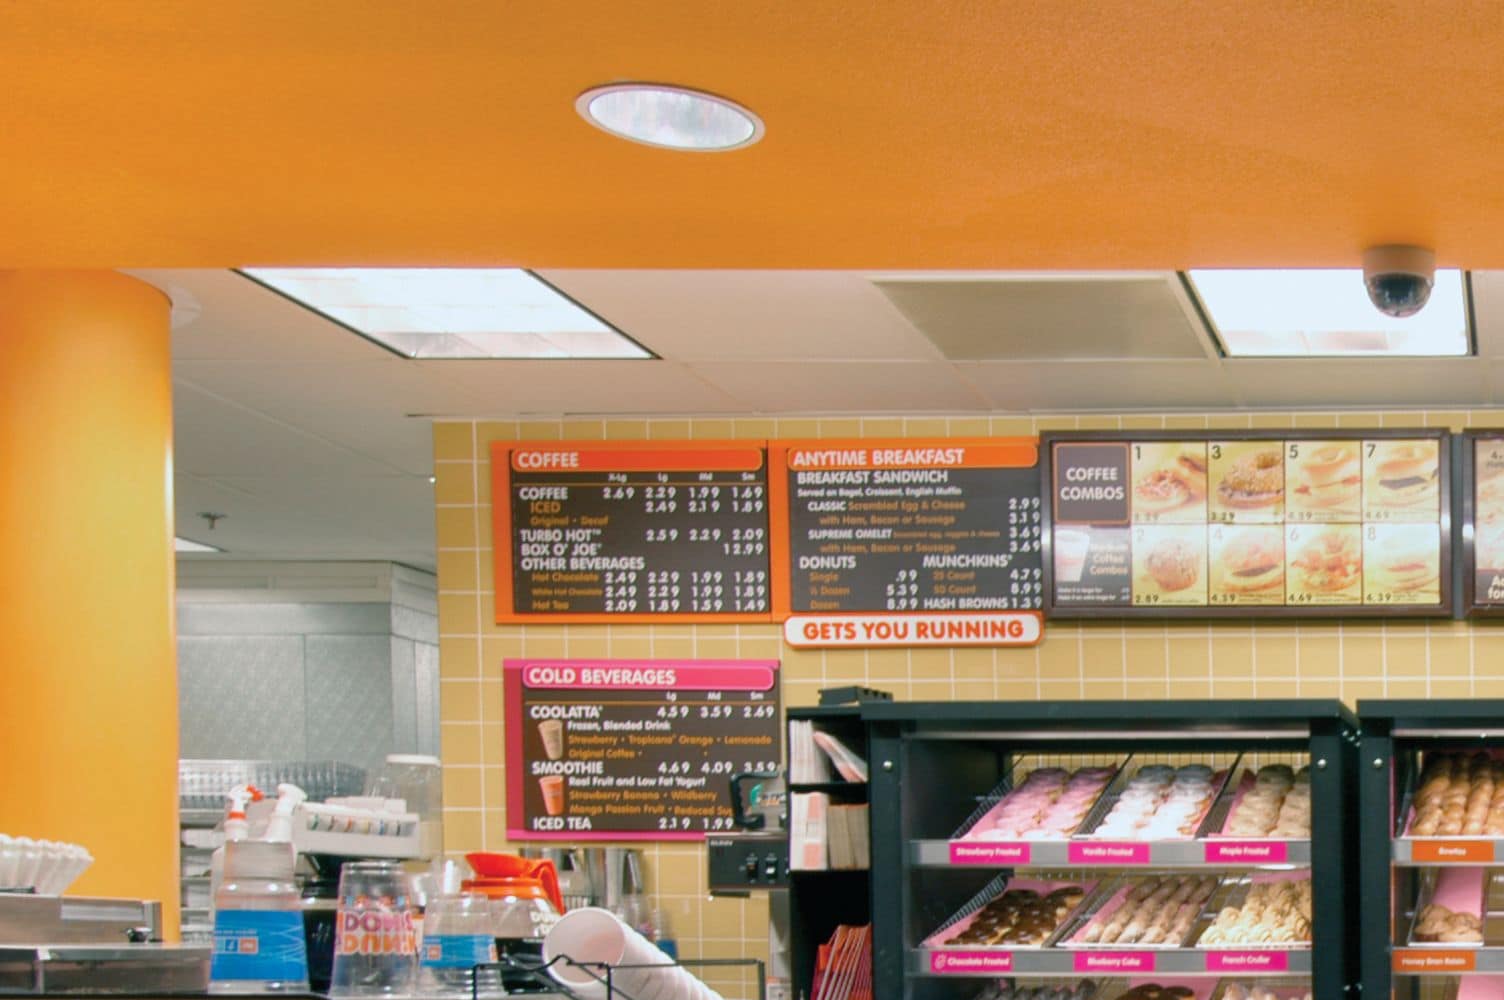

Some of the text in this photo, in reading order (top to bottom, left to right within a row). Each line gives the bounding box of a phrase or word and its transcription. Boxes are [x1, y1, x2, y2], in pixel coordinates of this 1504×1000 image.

[794, 449, 965, 466] ANYTIME BREAKFAST
[1134, 444, 1375, 460] 1 3 5 7
[518, 452, 579, 467] COFFEE
[798, 471, 948, 484] BREAKFAST SANDWICH
[1066, 468, 1118, 481] COFFEE
[519, 487, 762, 499] COFFEE 2.69 2.29 1.99 1.69
[1060, 487, 1124, 500] COMBOS
[531, 501, 720, 512] ICED 2.49 2.19
[808, 498, 1040, 511] CLASSIC 2.99
[1010, 512, 1040, 523] 3.19
[521, 529, 763, 541] TURBO 2.59 2.29 2.09
[808, 530, 852, 539] SUPREME
[1010, 527, 1040, 538] 3.69
[521, 544, 763, 555] BOX 12.99
[1010, 541, 1040, 552] 3.69
[522, 557, 644, 569] OTHER BEVERAGES
[800, 557, 856, 568] DONUTS
[605, 572, 722, 583] 2.49 2.29 1.99
[896, 569, 1041, 581] .99 4.79
[605, 586, 722, 597] 2.49 2.29 1.99
[887, 584, 1041, 595] 5.39 8.99
[1489, 587, 1504, 599] for
[605, 600, 765, 611] 2.09 1.59 1.49
[888, 598, 1041, 609] 8.99 HASH BROWNS 1.39
[804, 620, 1024, 639] GETS YOU RUNNING
[529, 669, 676, 684] COLD BEVERAGES
[657, 706, 774, 717] 4.59 3.59 2.69
[604, 721, 671, 730] Blended Drink
[679, 736, 713, 746] Orange
[569, 750, 635, 760] Original Coffee
[532, 762, 732, 774] SMOOTHIE 4.69 4.09
[569, 776, 705, 787] Real Fruit and Low Fat Yogurt
[671, 790, 716, 800] Wildberry
[534, 818, 733, 829] ICED TEA 2.19 1.99
